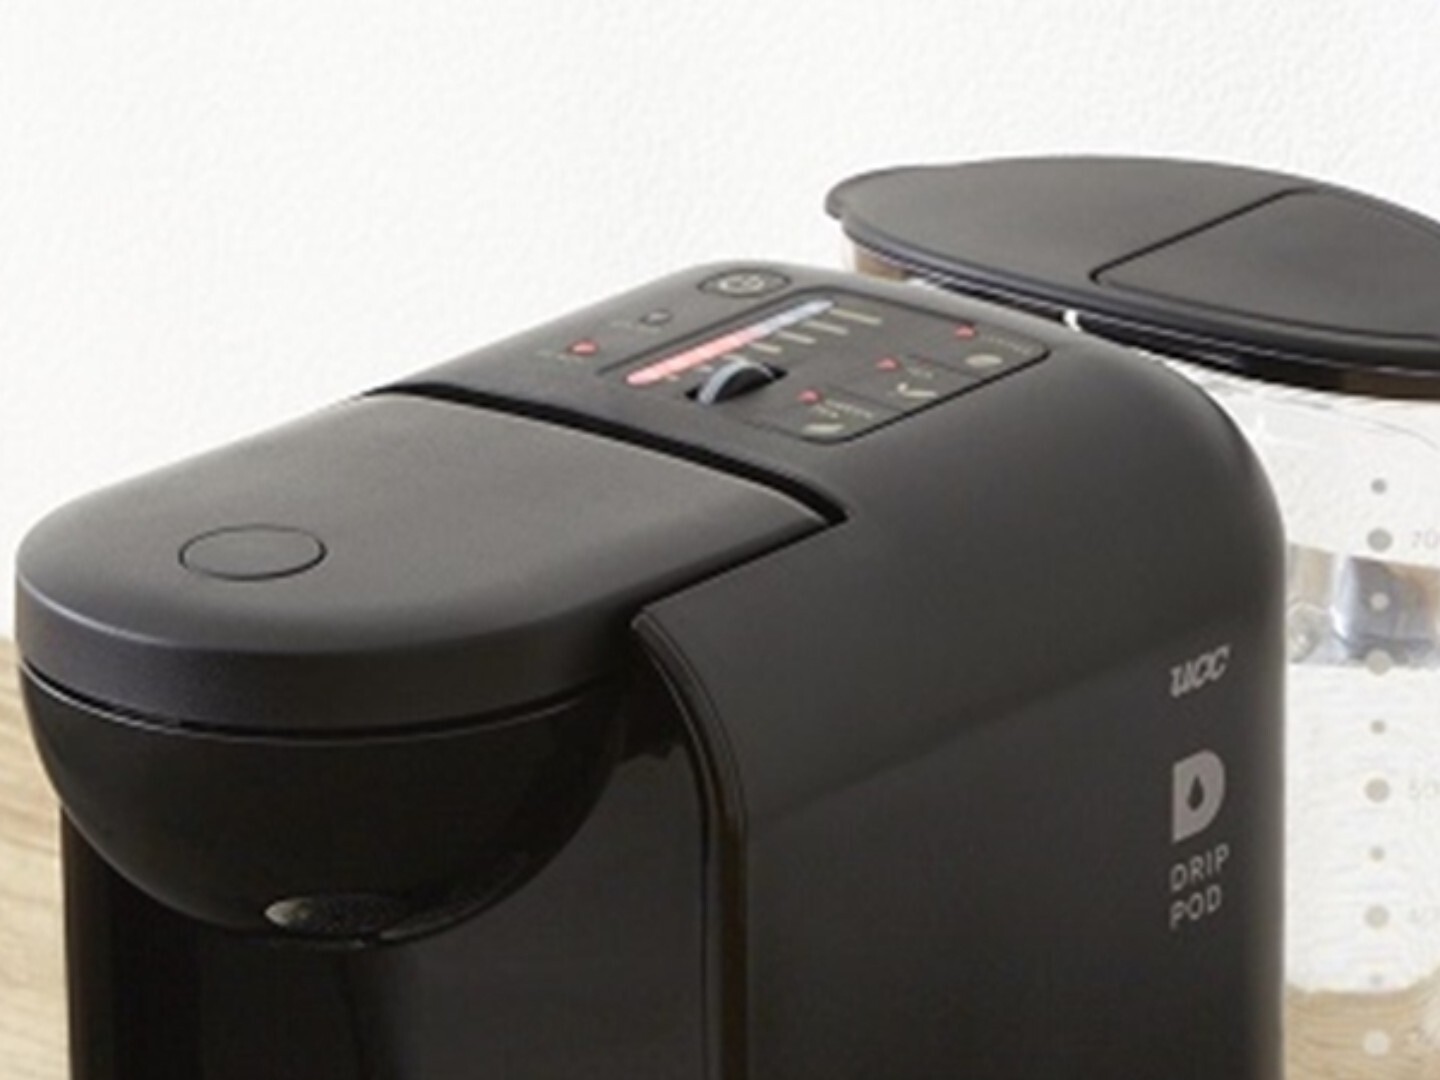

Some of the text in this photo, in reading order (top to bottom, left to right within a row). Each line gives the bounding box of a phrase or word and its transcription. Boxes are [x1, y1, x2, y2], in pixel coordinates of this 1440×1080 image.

[1170, 644, 1230, 698] UCC
[1170, 843, 1230, 893] DRIP
[1170, 883, 1222, 931] POD
